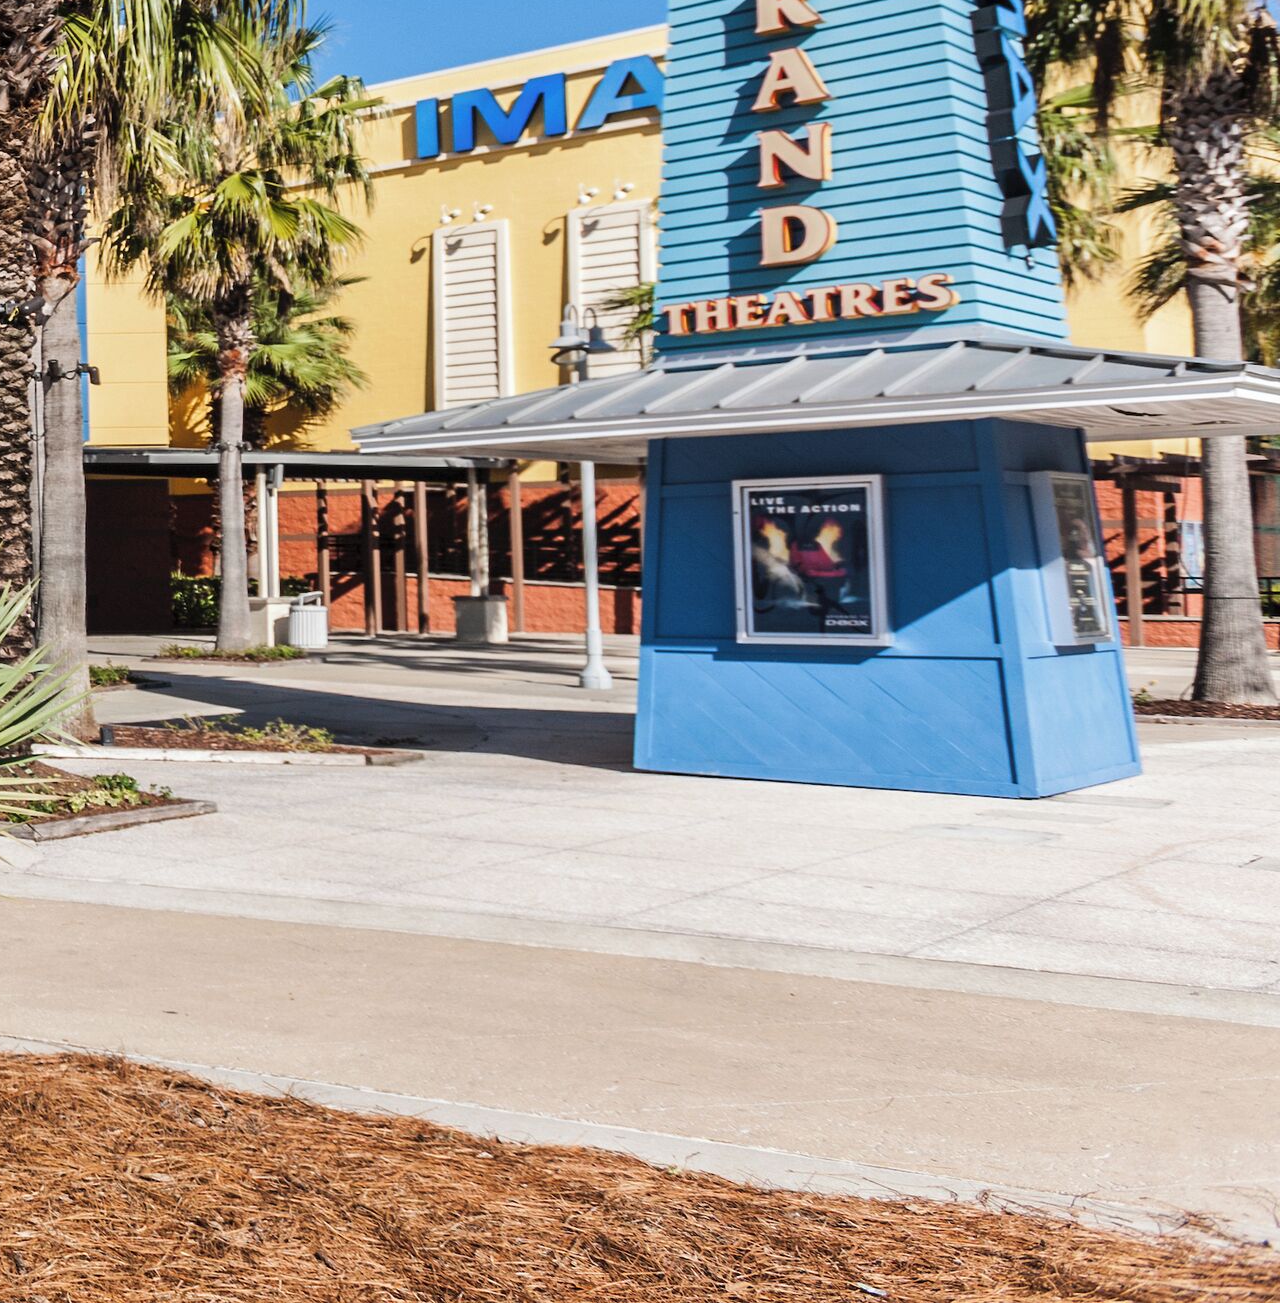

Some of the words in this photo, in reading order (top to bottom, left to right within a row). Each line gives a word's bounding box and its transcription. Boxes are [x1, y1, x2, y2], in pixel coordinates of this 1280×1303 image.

[415, 54, 665, 159] IMA
[662, 273, 960, 335] THEATRES
[751, 497, 784, 506] LIVE
[767, 506, 796, 514] THE
[800, 504, 861, 514] ACTION
